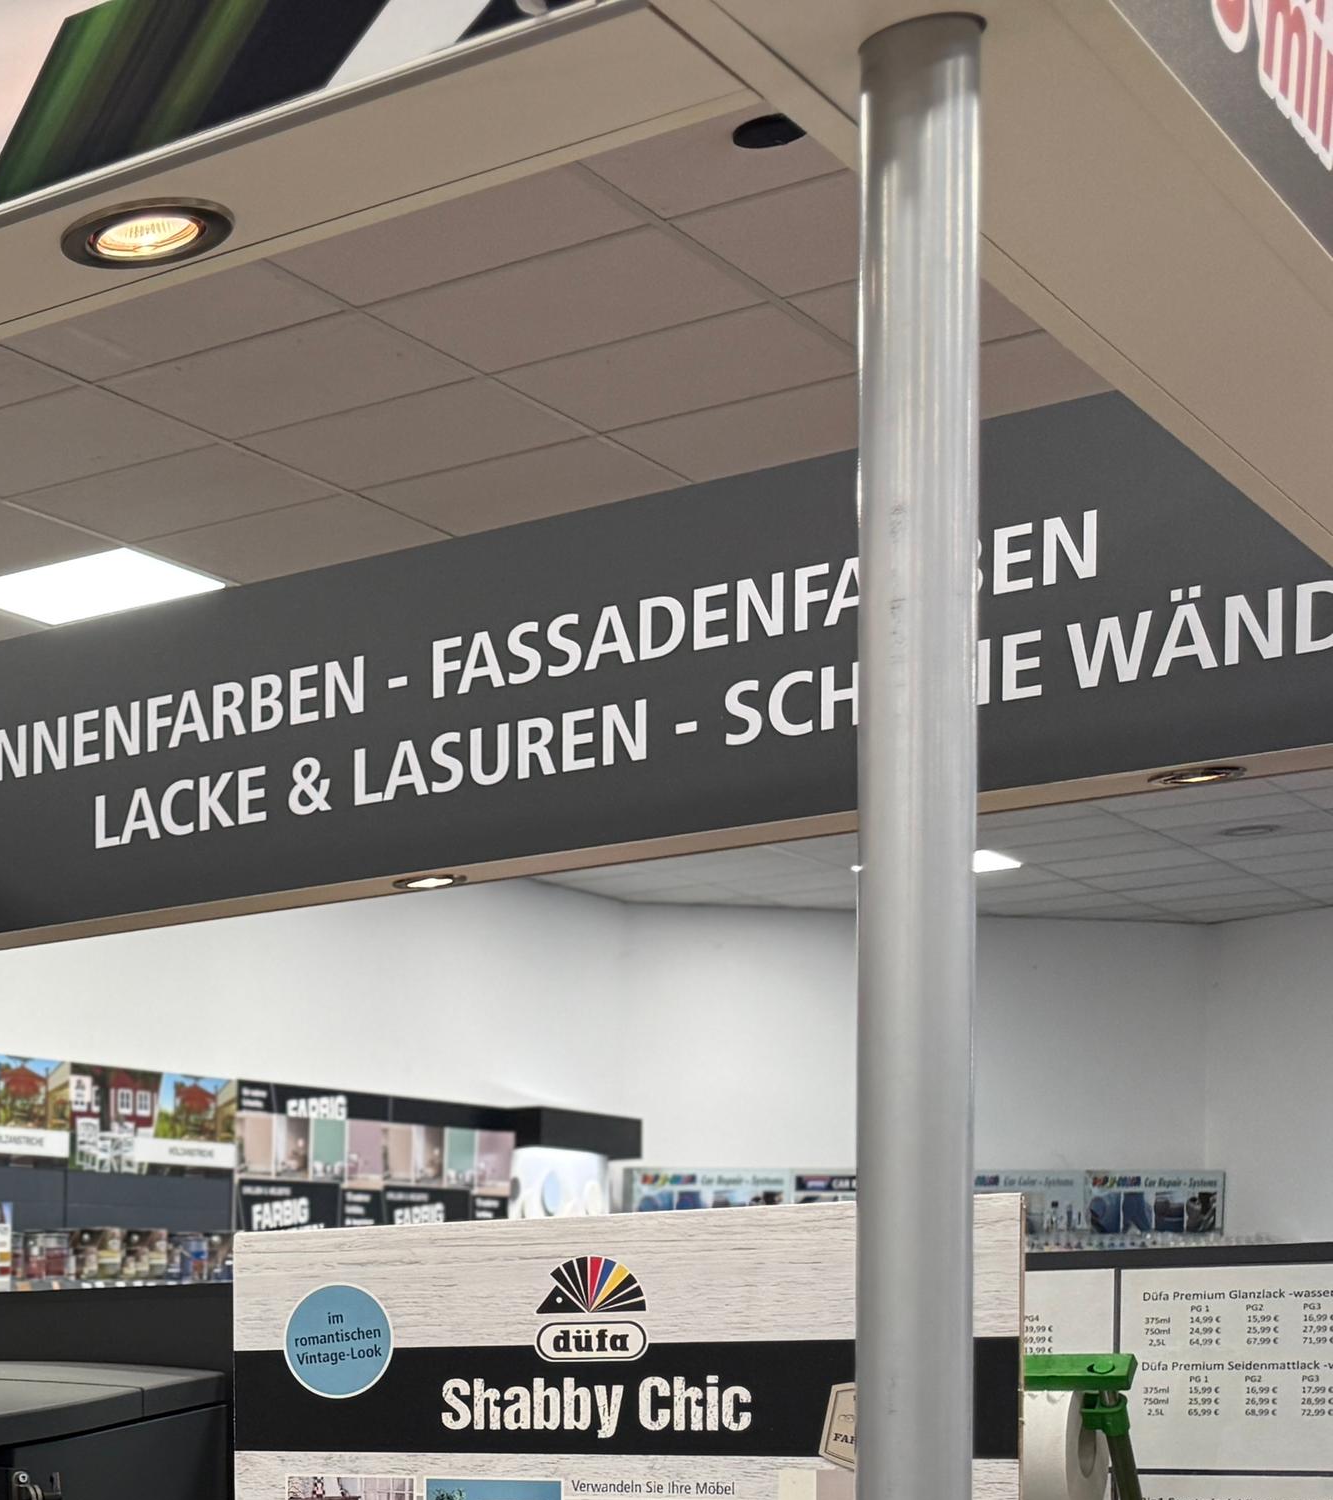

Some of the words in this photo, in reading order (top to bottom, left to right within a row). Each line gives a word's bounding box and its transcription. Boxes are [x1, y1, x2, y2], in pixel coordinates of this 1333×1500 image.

[431, 510, 1099, 700] FASSADENFAEN
[93, 766, 268, 849] LACKE
[288, 757, 335, 816] &
[353, 699, 649, 806] LASUREN
[723, 630, 1043, 747] SCHE
[1143, 1292, 1169, 1302] Düfa
[1173, 1291, 1226, 1301] Premium
[1229, 1289, 1285, 1300] Glanzlack
[327, 1312, 344, 1324] im
[1145, 1316, 1171, 1324] 375ml
[1189, 1316, 1211, 1324] 14,99
[1247, 1316, 1271, 1324] 15,99
[1145, 1327, 1171, 1335] 750ml
[1189, 1327, 1212, 1335] 24,99
[1247, 1326, 1271, 1334] 25,99
[294, 1327, 381, 1347] romantischen
[553, 1329, 629, 1353] düfa
[1189, 1338, 1211, 1346] 64,99
[297, 1345, 382, 1366] Vintage-Look
[1141, 1362, 1168, 1372] Düfa
[1172, 1362, 1225, 1371] Premium
[1228, 1360, 1320, 1371] Seidenmattlack
[1143, 1386, 1169, 1394] 375ml
[1189, 1386, 1211, 1395] 15,99
[1245, 1386, 1269, 1394] 16,99
[441, 1377, 624, 1439] Shabby
[638, 1375, 752, 1431] Chic
[1143, 1398, 1169, 1406] 750ml
[1188, 1398, 1211, 1406] 25,99
[1188, 1408, 1211, 1416] 65,99
[572, 1480, 642, 1494] Verwandeln
[645, 1481, 665, 1494] Sie
[668, 1481, 691, 1495] Ihre
[695, 1481, 735, 1496] Möbel
